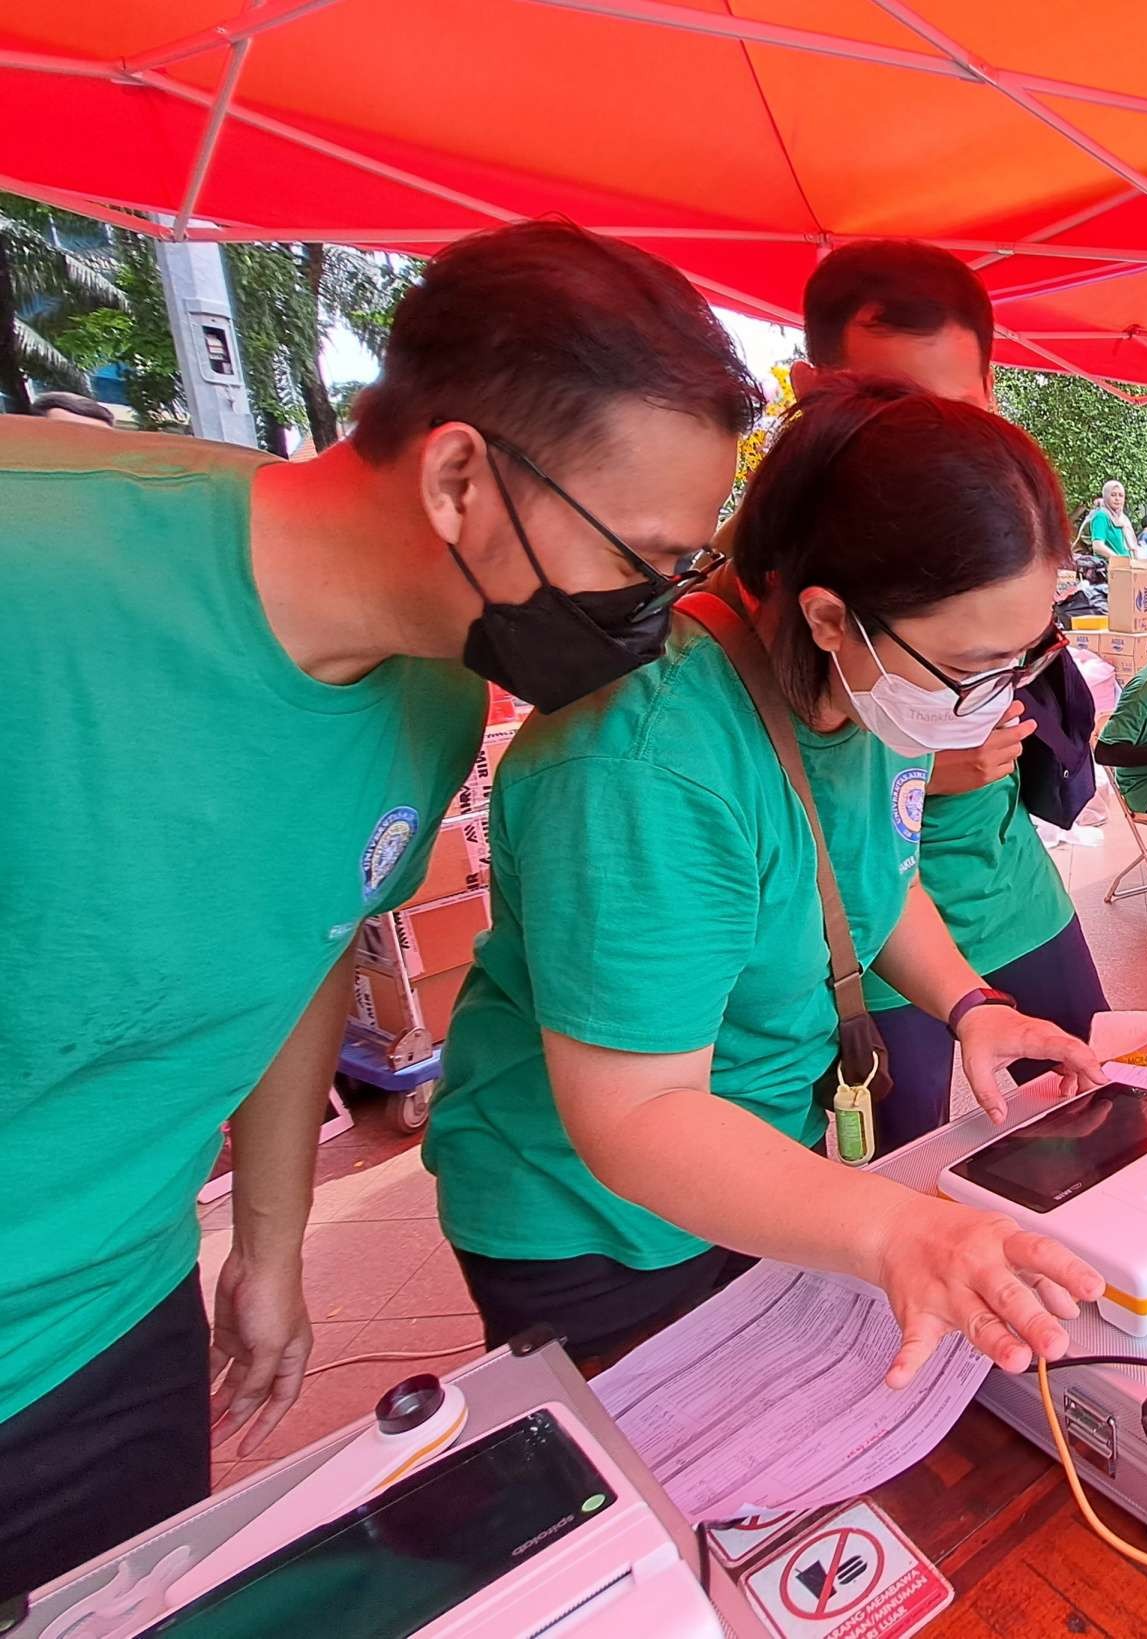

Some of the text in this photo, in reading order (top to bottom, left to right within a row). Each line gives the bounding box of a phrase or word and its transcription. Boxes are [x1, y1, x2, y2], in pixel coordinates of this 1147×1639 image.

[909, 708, 957, 722] Thankfu
[511, 1514, 575, 1556] spirolab
[866, 1569, 921, 1613] MEMBAWA
[879, 1605, 908, 1629] LUAR
